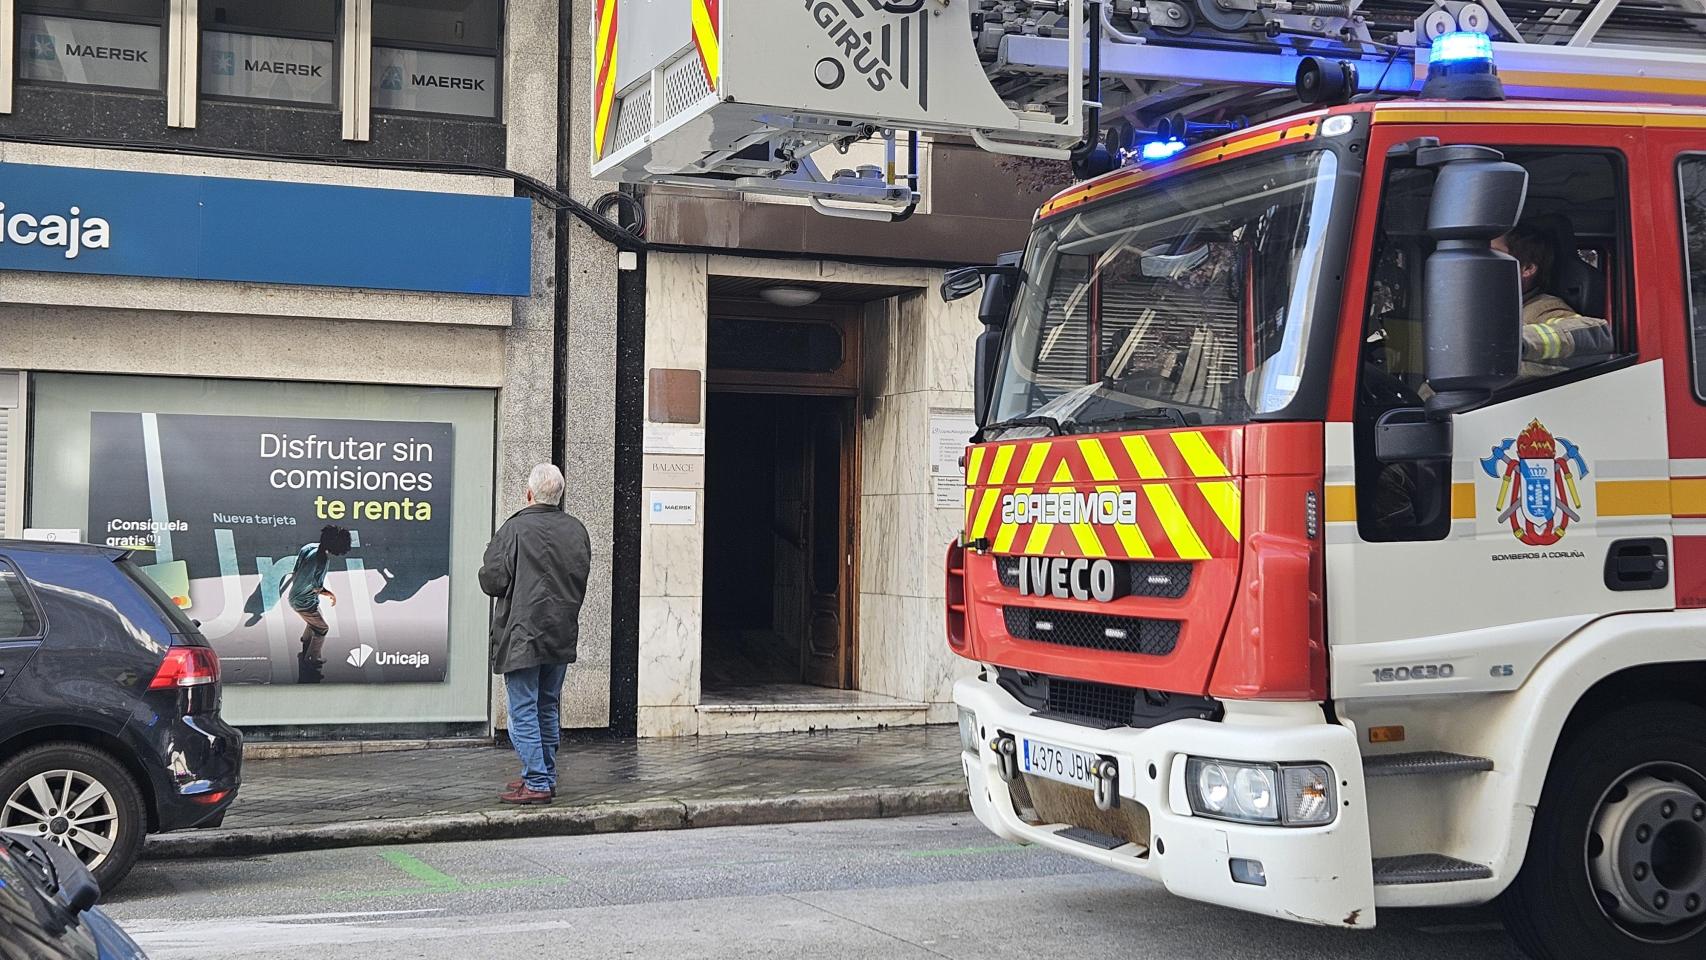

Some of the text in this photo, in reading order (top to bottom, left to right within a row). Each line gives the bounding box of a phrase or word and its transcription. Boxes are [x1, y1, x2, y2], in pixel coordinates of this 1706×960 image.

[65, 43, 148, 63] MAERSK
[244, 58, 323, 78] MAERSK
[411, 74, 486, 92] MAERSK
[260, 433, 433, 462] Disfrutar sin
[652, 463, 694, 471] BALANCE
[269, 466, 433, 491] comisiones
[314, 495, 432, 521] te renta
[107, 518, 188, 533] ¡Consíguela
[213, 512, 297, 527] Nueva tarjeta
[1491, 552, 1540, 561] BOMBEROS
[1549, 550, 1585, 559] CORUÑA
[1019, 556, 1115, 603] IVECO
[375, 651, 430, 668] Unicaja
[1032, 744, 1064, 776] 4376
